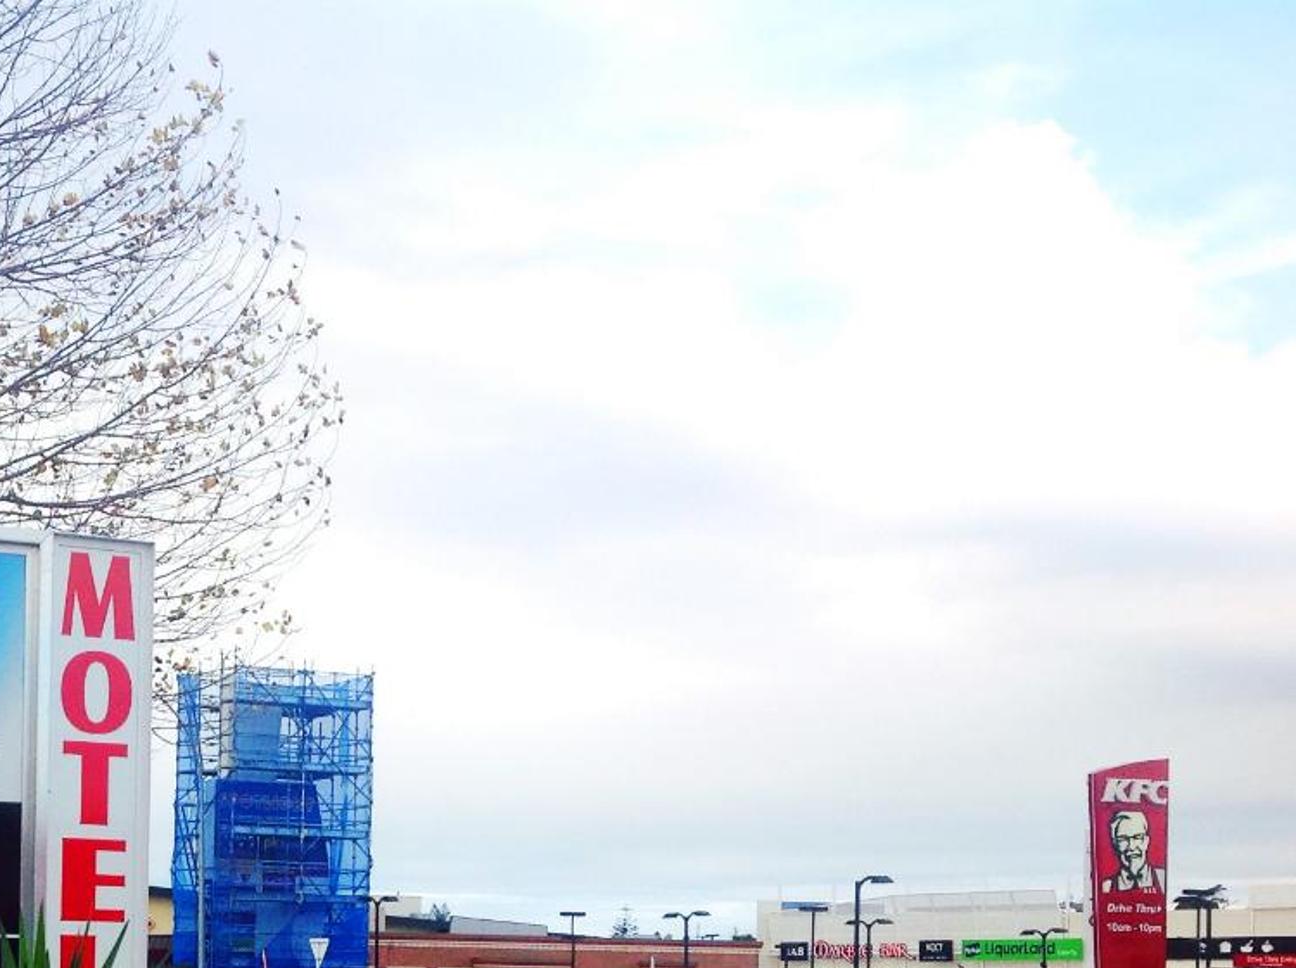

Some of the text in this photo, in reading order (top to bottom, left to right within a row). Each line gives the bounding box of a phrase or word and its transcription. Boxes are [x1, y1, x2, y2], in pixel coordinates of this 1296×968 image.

[1101, 778, 1169, 804] KFC
[1107, 903, 1157, 914] Drive Thru
